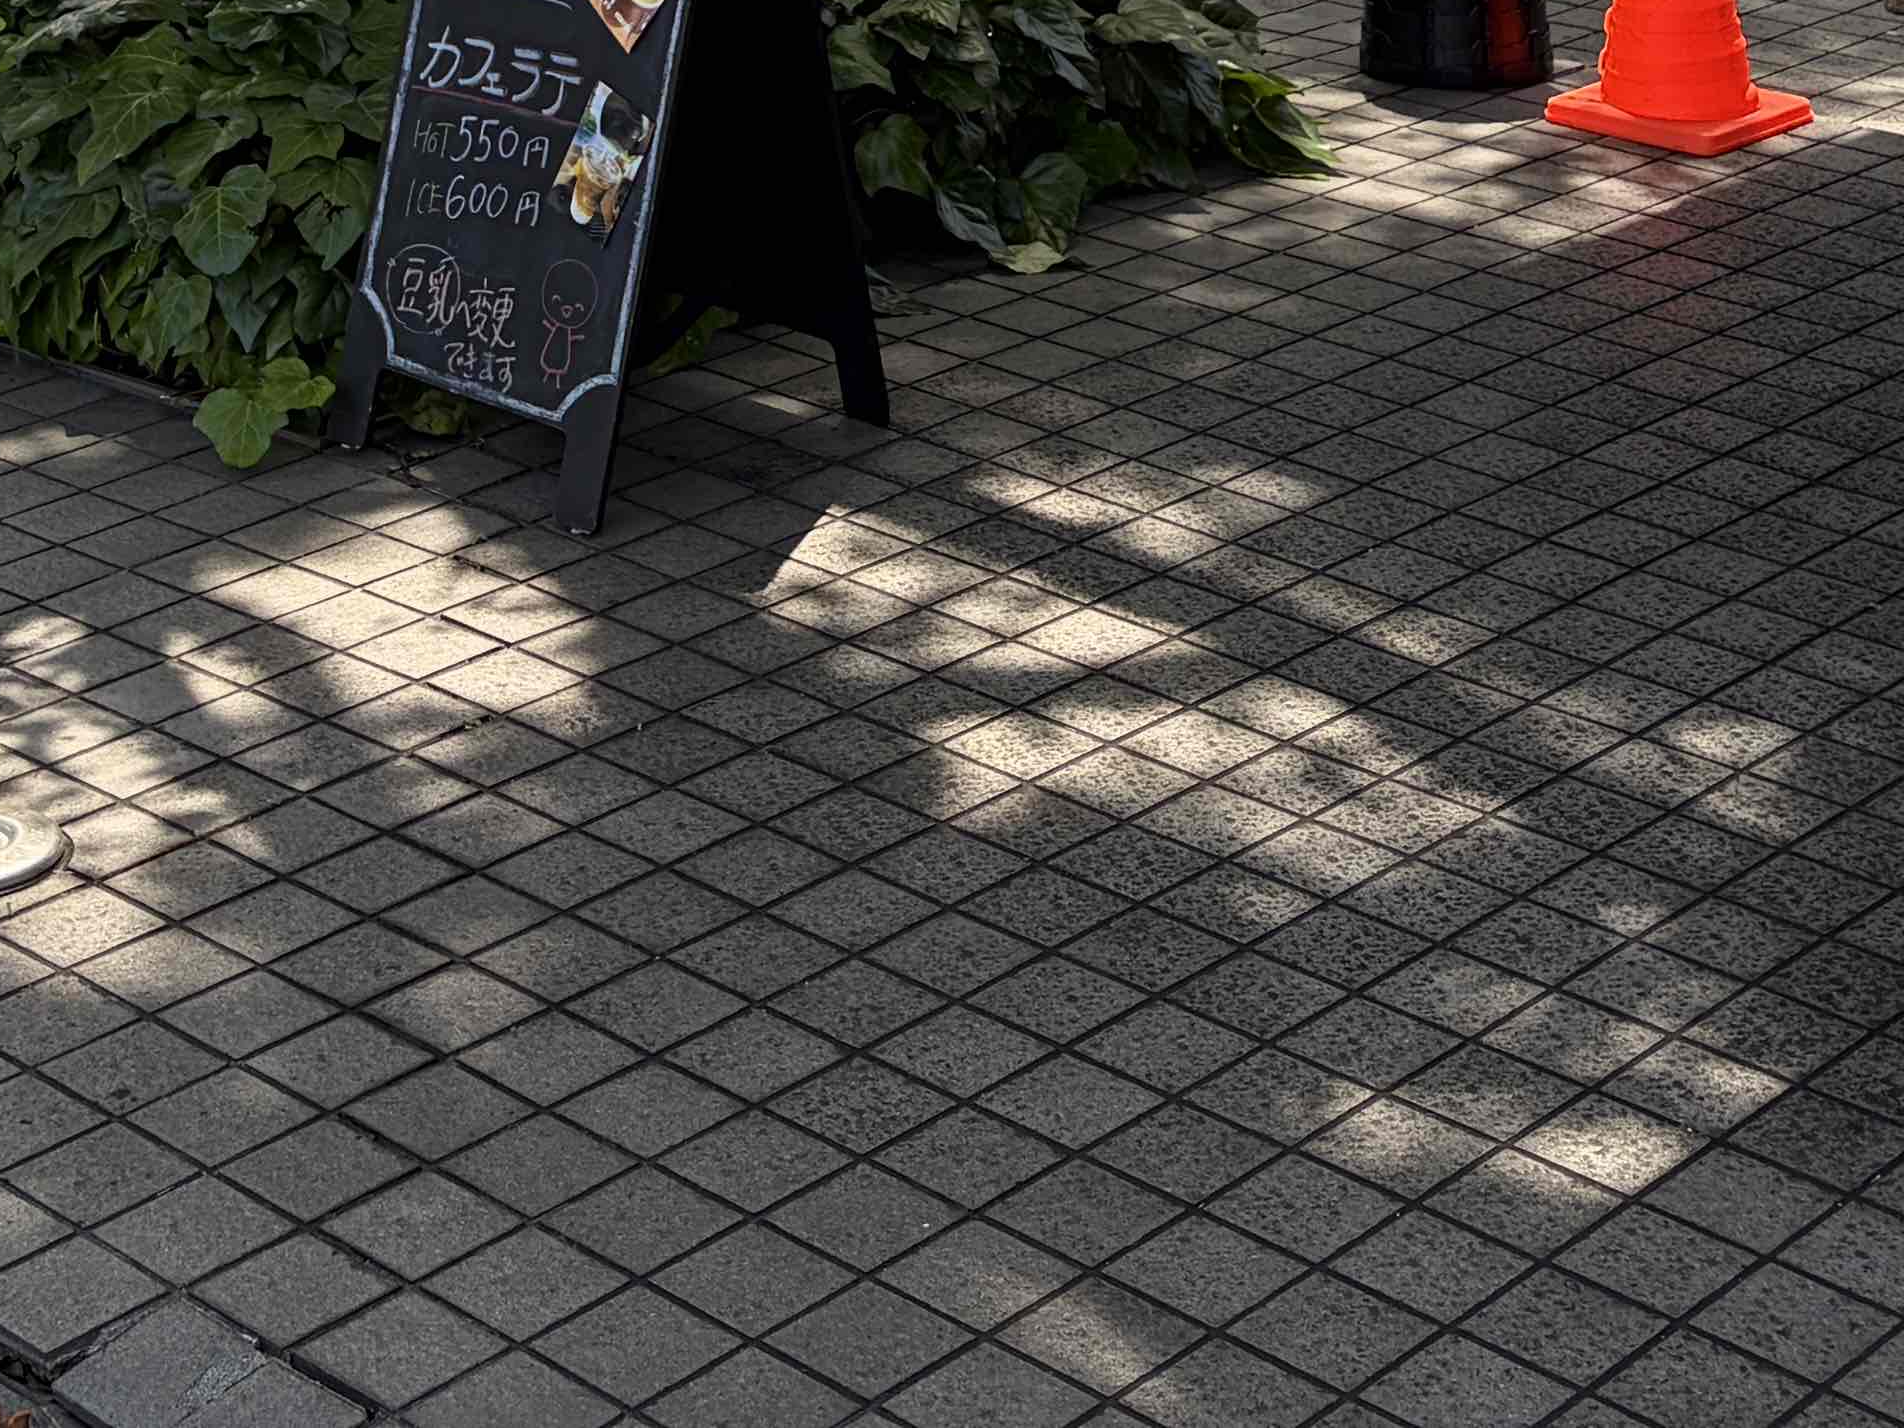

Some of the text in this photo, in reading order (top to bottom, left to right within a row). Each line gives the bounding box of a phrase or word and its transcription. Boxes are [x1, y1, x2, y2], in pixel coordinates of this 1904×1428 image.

[419, 25, 583, 117] カフェラテ
[443, 340, 514, 393] できます
